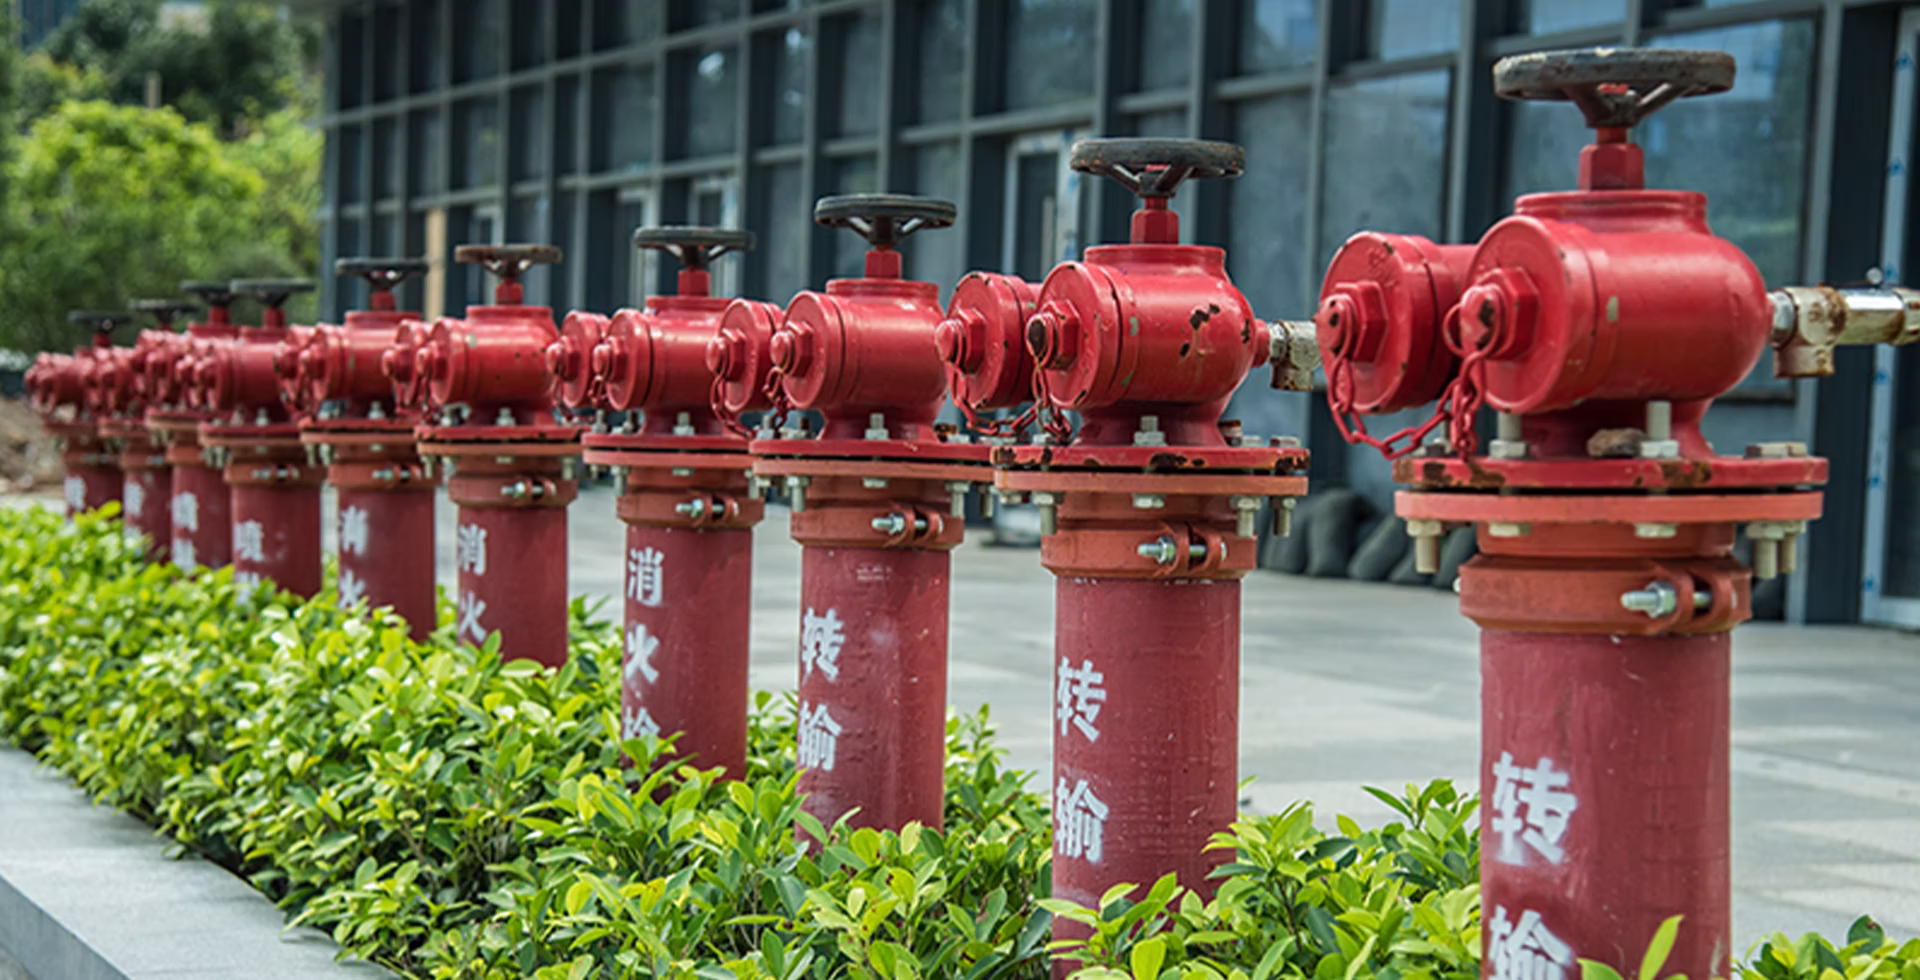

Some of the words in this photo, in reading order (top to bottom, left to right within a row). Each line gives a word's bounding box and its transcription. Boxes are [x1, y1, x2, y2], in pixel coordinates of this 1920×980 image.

[799, 605, 846, 771] 转输
[1056, 655, 1109, 865] 转输
[1488, 750, 1578, 980] 转输
